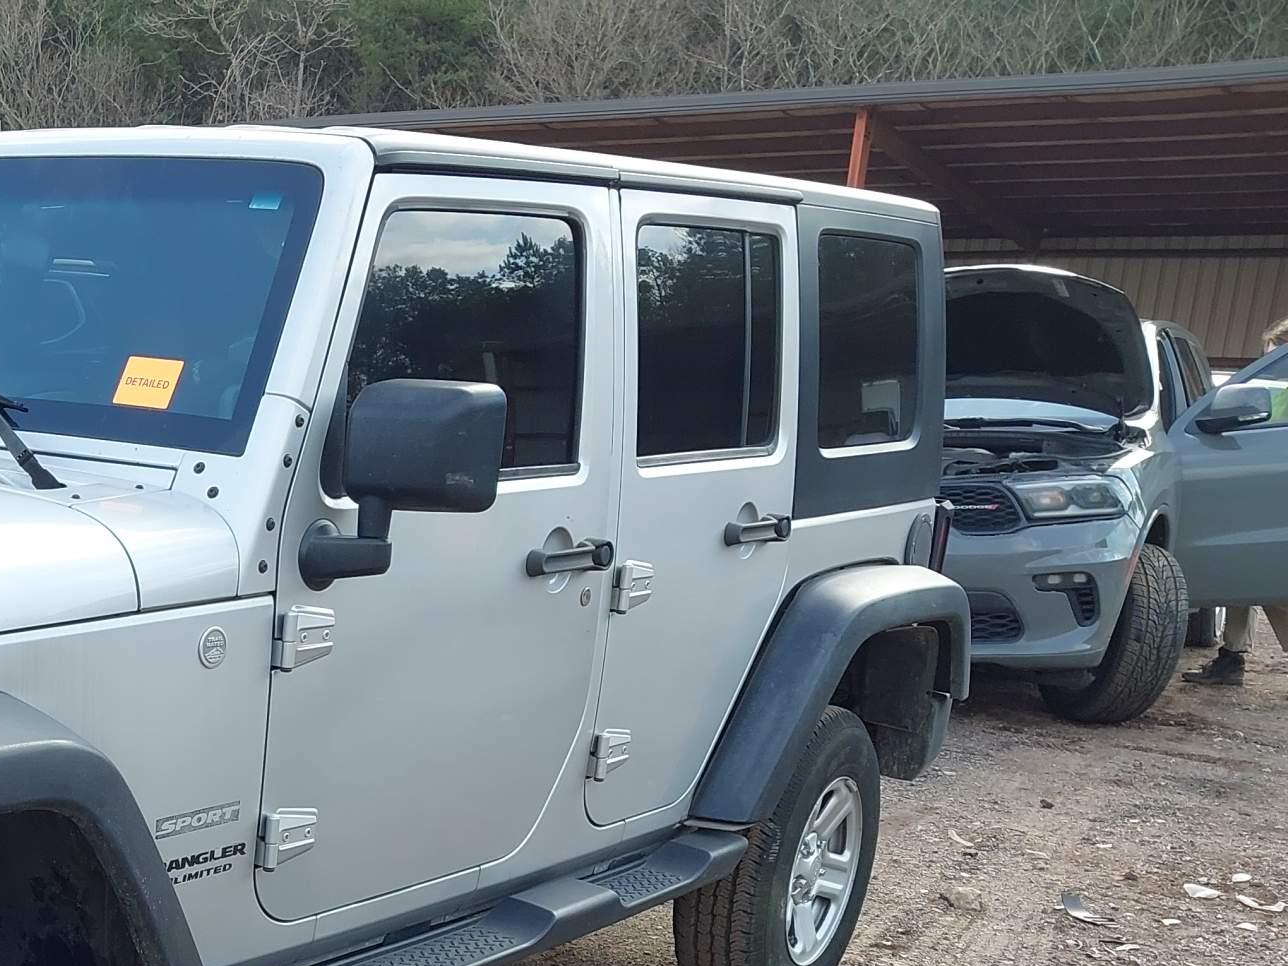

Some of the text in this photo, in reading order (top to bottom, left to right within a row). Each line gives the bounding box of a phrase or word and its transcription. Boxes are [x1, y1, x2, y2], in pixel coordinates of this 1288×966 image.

[125, 376, 170, 390] DETAILED
[155, 805, 240, 836] SPORT
[164, 843, 247, 873] ANGLER
[171, 863, 233, 886] LIMITED
